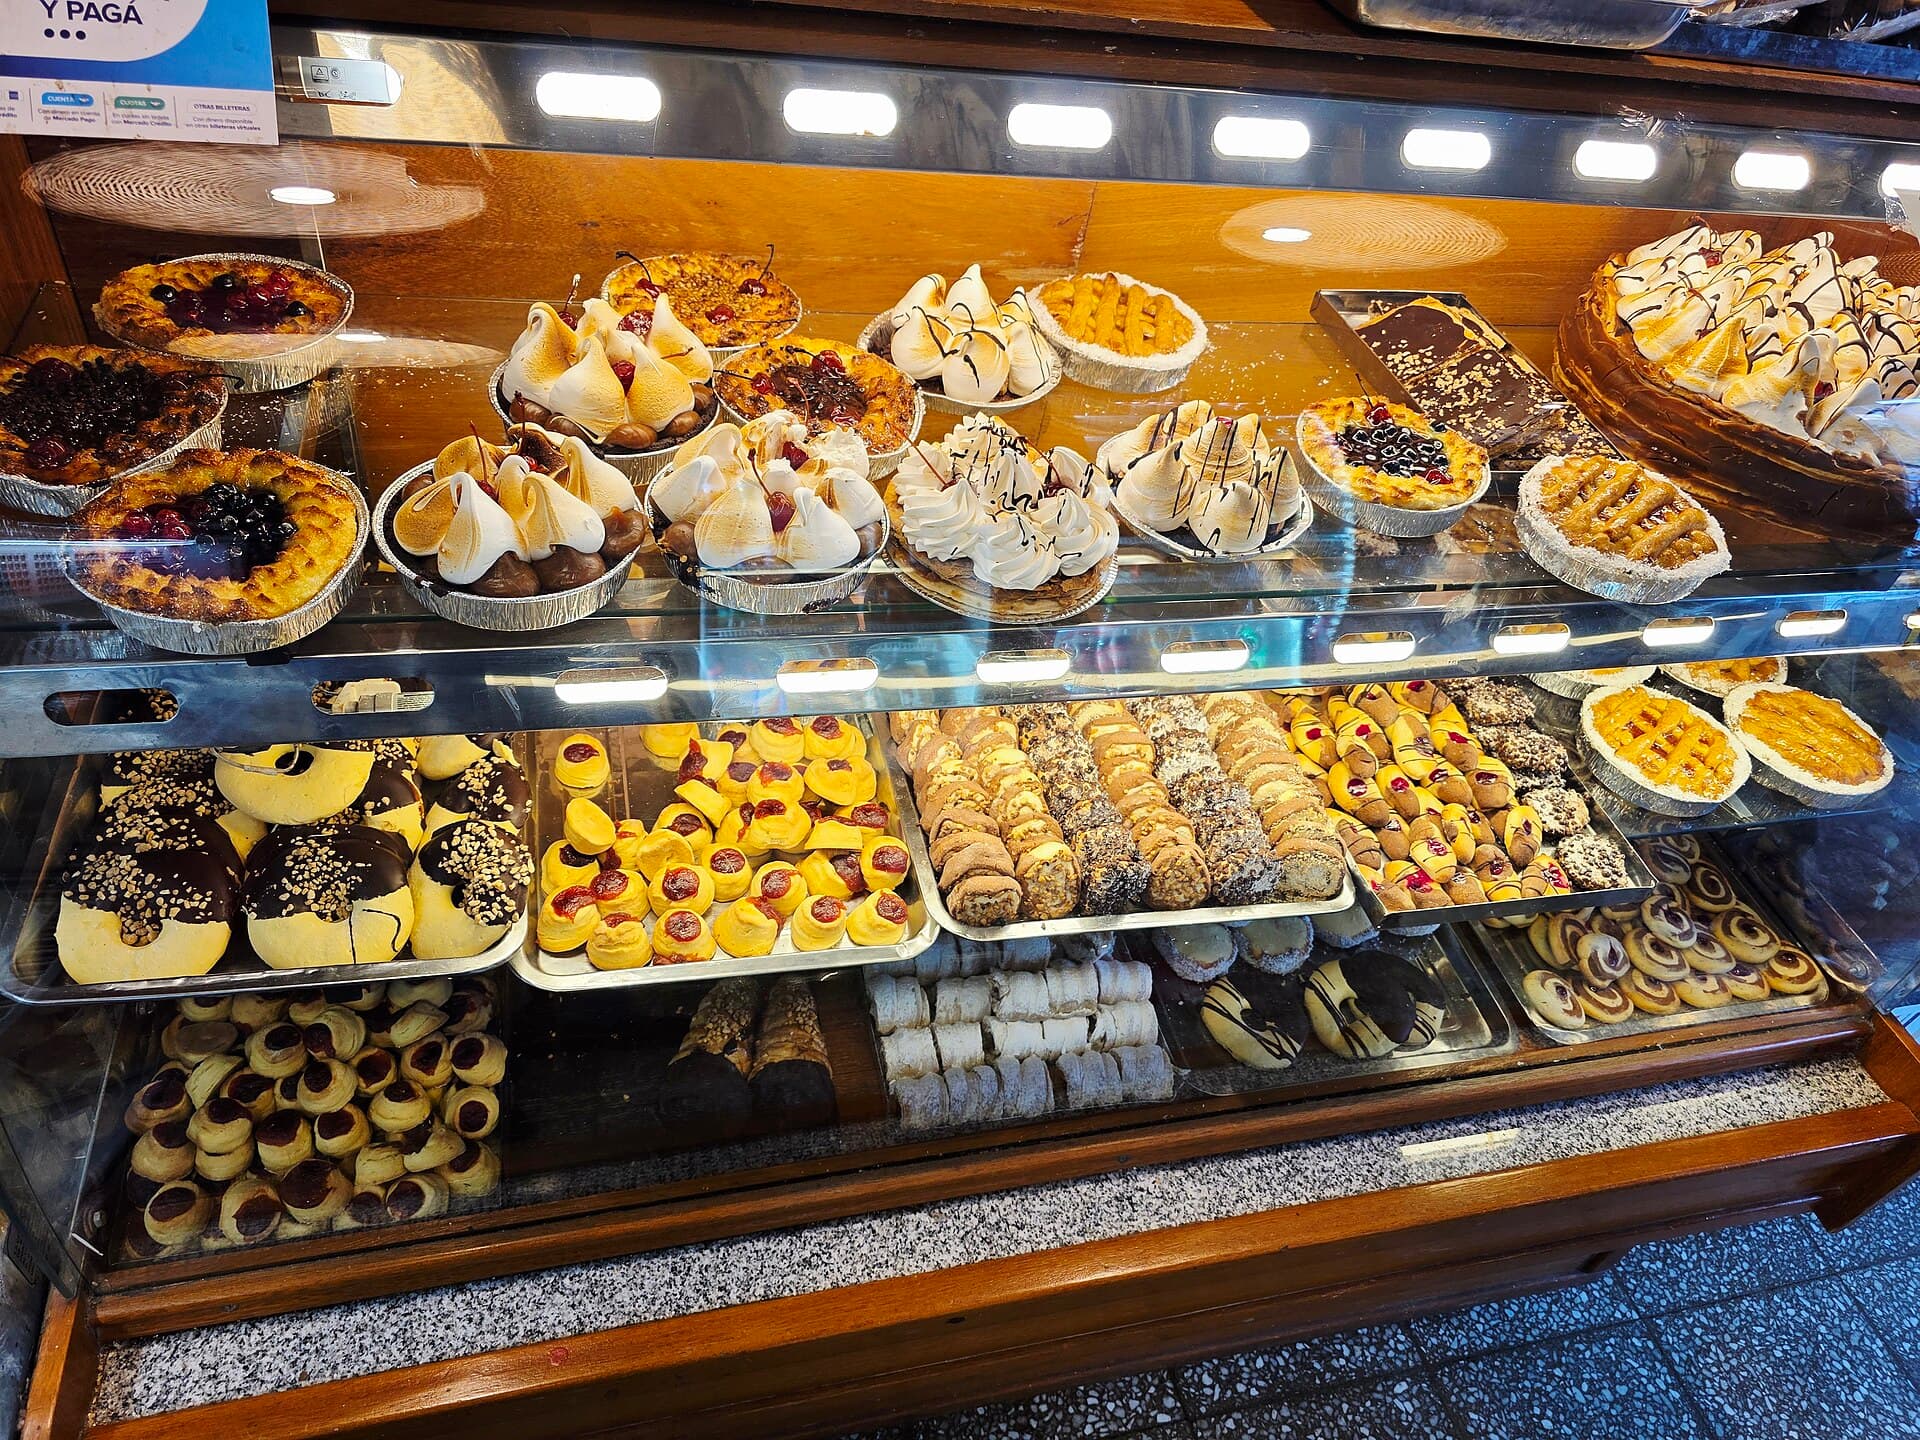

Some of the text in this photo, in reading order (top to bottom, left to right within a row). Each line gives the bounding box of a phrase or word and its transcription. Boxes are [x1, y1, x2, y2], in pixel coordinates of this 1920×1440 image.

[39, 0, 144, 25] Y PAGÁ
[47, 95, 75, 103] CUENTA
[215, 104, 251, 112] BILLETERAS
[80, 116, 97, 124] Pago
